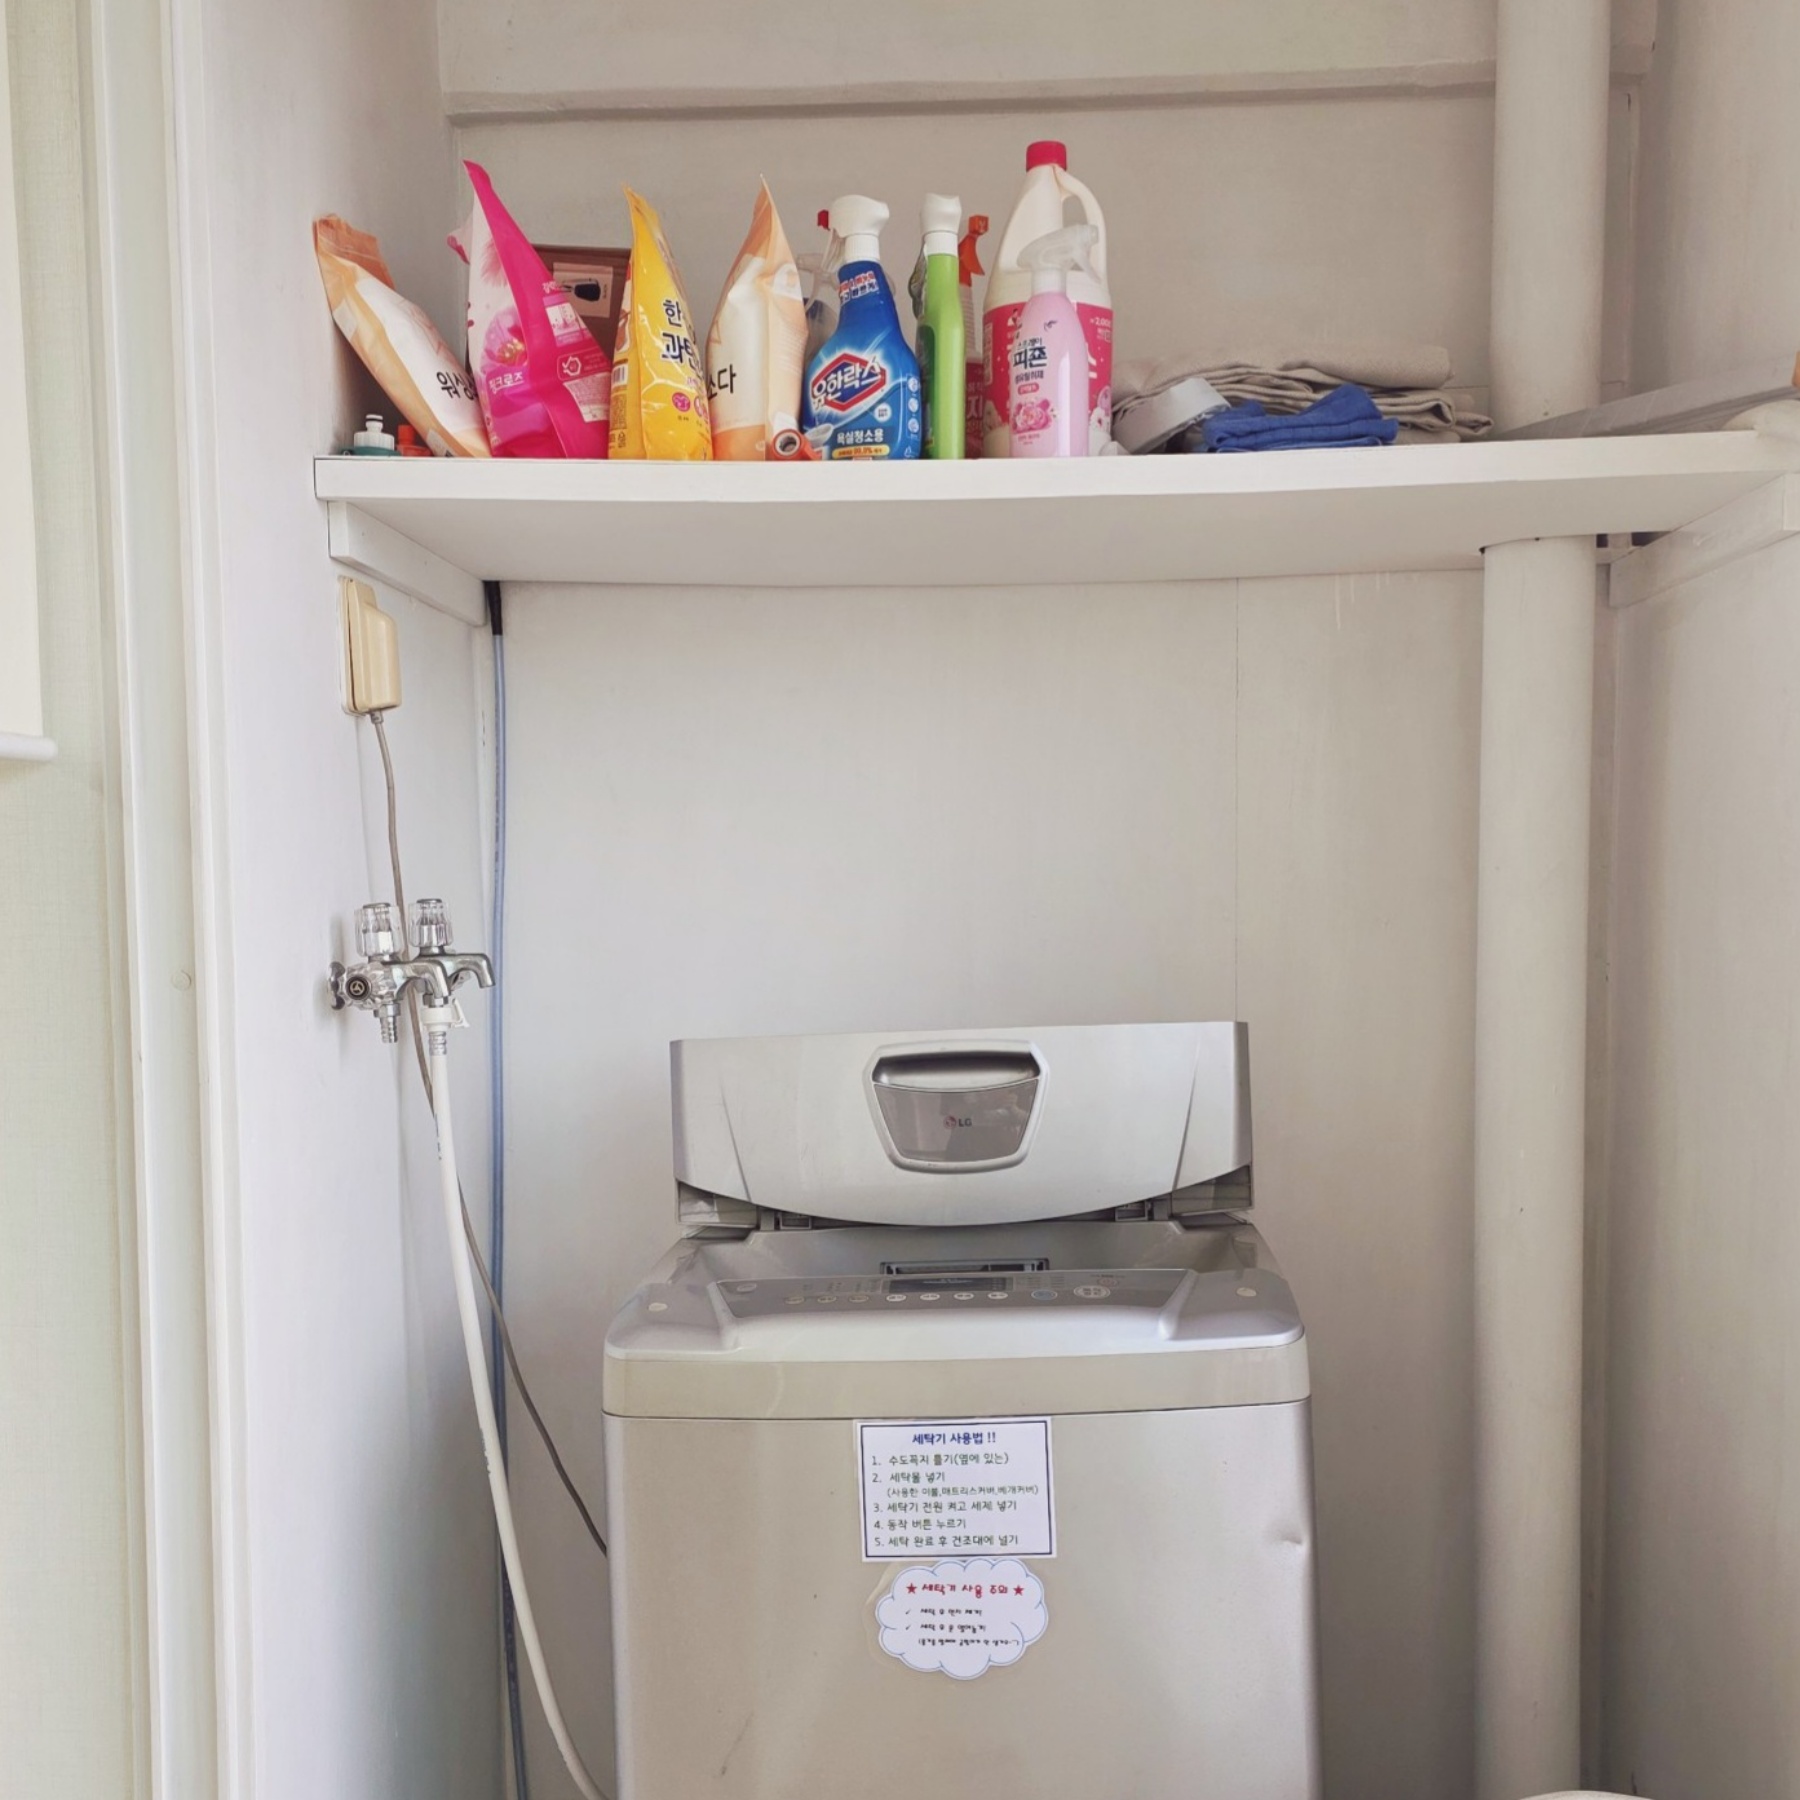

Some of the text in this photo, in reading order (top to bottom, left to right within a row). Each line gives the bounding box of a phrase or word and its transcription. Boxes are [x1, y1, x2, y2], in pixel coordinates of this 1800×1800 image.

[1013, 346, 1048, 369] 피죤
[436, 371, 478, 401] 워싱
[812, 355, 882, 410] 유한락스
[836, 428, 885, 446] 욕실청소용
[958, 1118, 973, 1128] LG
[912, 1432, 996, 1445] 세탁기 사용법 !!
[889, 1454, 929, 1465] 수도꼭지
[889, 1473, 921, 1483] 세탁물
[925, 1472, 945, 1483] 넣기
[887, 1488, 919, 1498] (사용한
[887, 1502, 918, 1513] 세탁기
[922, 1502, 943, 1513] 전원
[947, 1501, 967, 1511] 켜고
[971, 1501, 993, 1511] 세제
[997, 1500, 1017, 1511] 넣기
[887, 1520, 908, 1530] 동작
[911, 1519, 932, 1529] 버튼
[936, 1519, 966, 1529] 누르기
[888, 1536, 909, 1547] 세탁
[913, 1536, 935, 1547] 완료
[938, 1536, 948, 1546] 후
[952, 1535, 995, 1546] 건조대에
[998, 1535, 1019, 1546] 널기
[922, 1583, 956, 1595] 세탁기
[962, 1584, 982, 1599] 사용
[920, 1608, 936, 1616] 세탁
